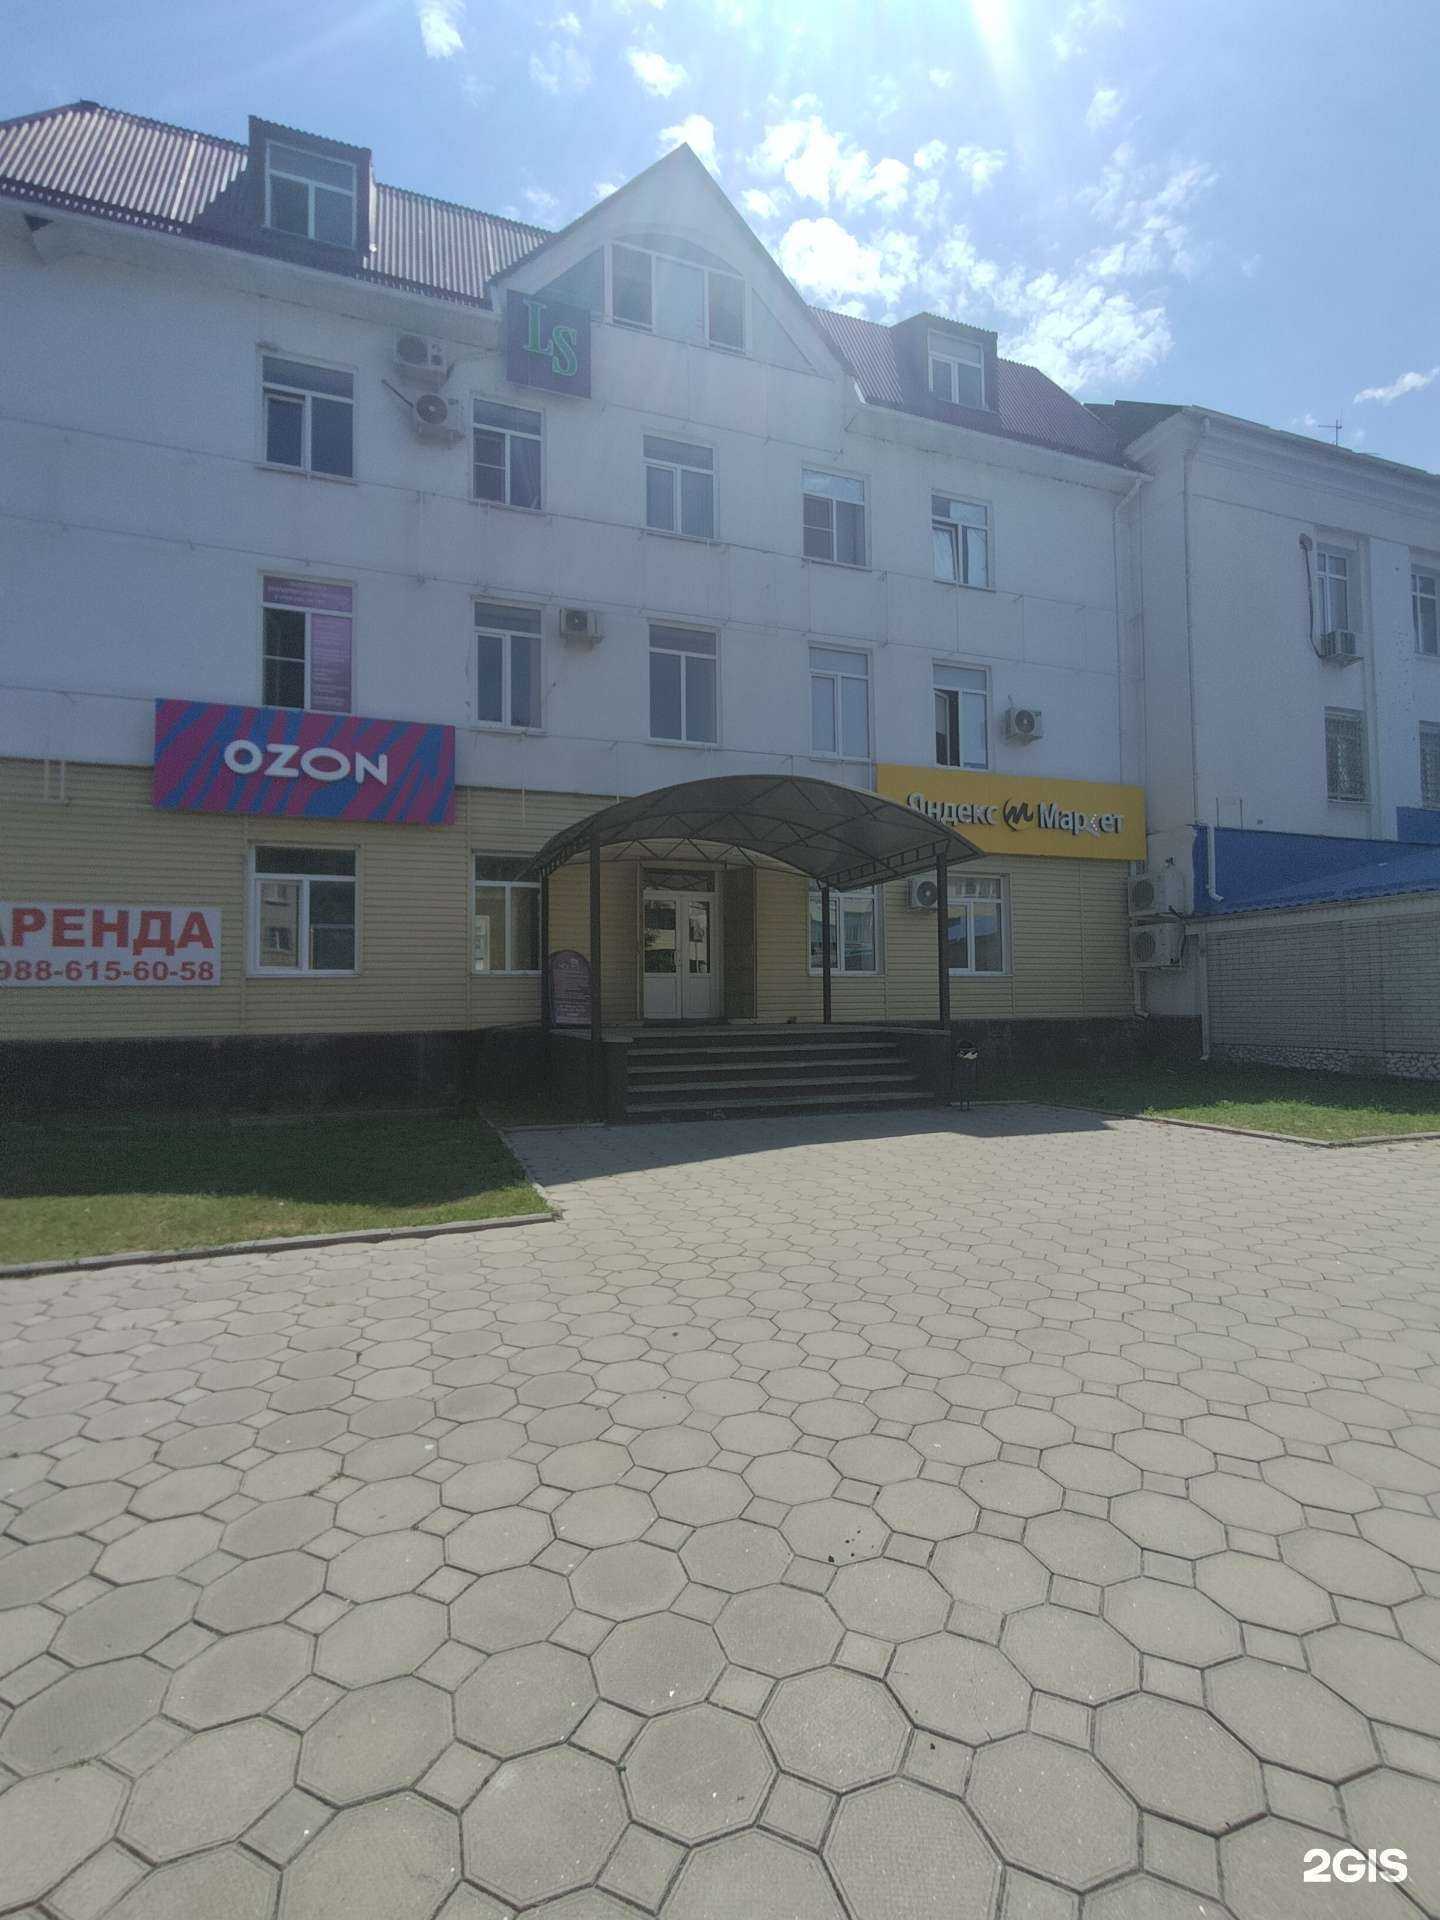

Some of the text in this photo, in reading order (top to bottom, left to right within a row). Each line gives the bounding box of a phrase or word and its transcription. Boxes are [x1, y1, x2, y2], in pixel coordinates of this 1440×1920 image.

[224, 739, 388, 785] OZON
[907, 793, 997, 826] Яндекс
[0, 908, 214, 956] РЕНДА
